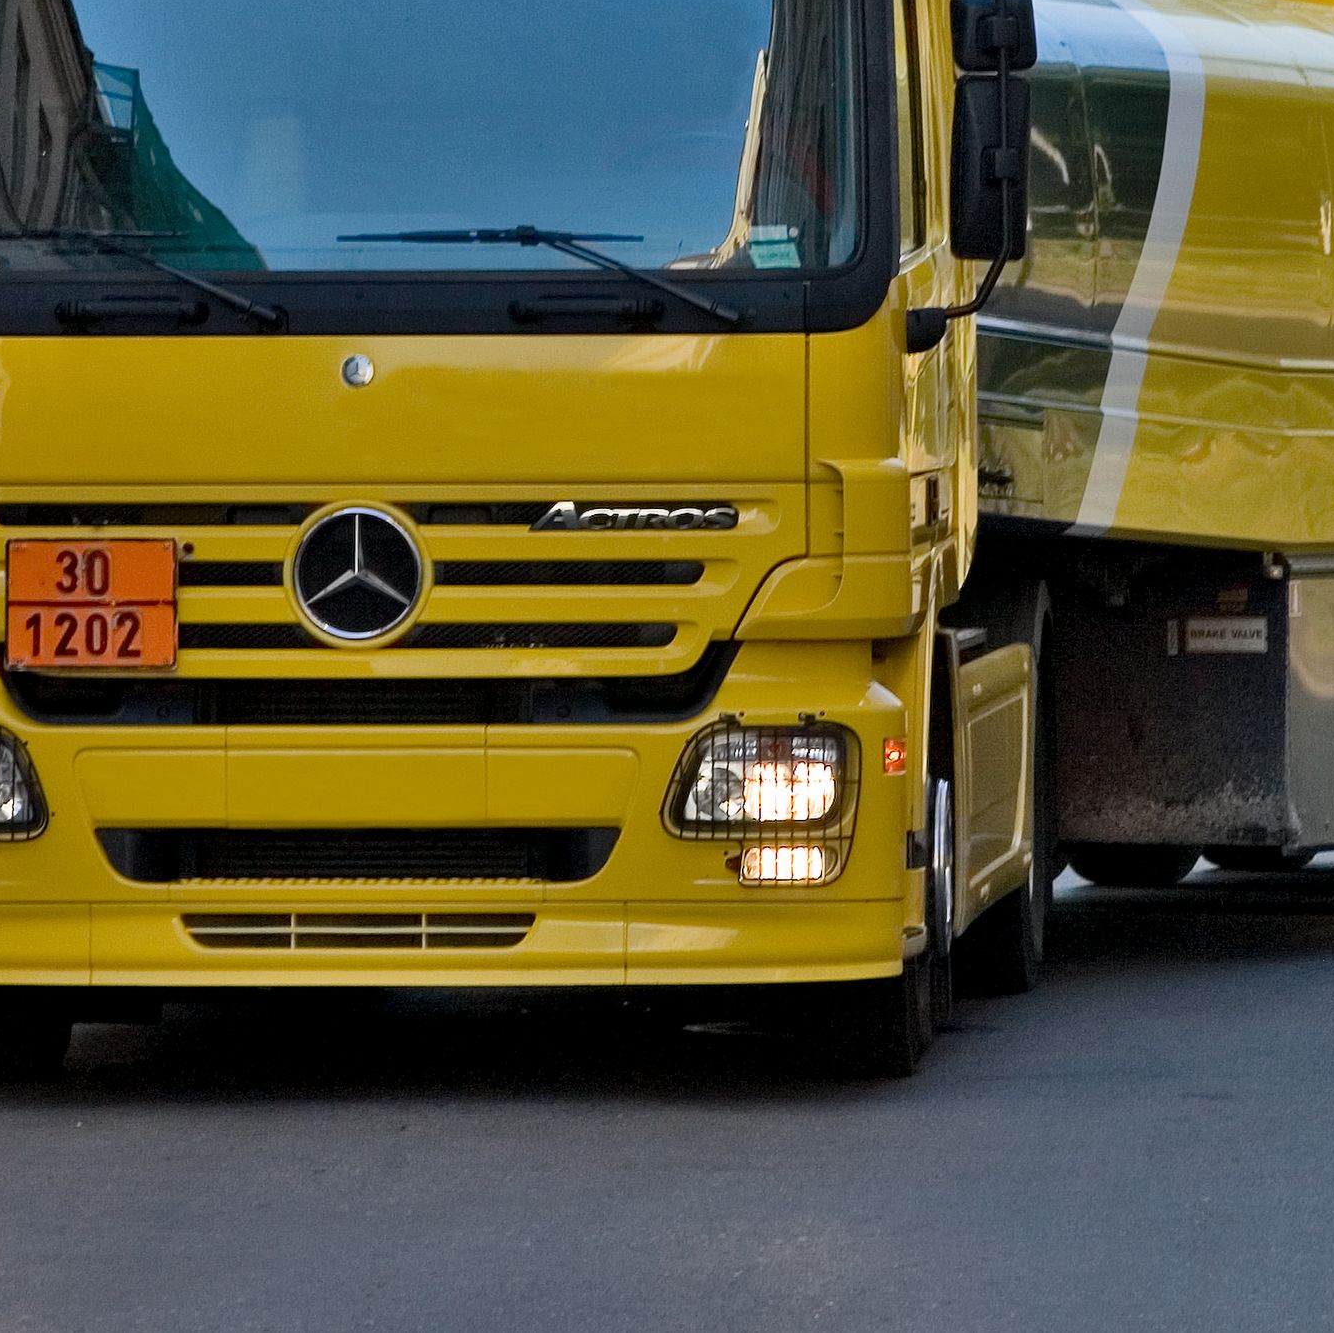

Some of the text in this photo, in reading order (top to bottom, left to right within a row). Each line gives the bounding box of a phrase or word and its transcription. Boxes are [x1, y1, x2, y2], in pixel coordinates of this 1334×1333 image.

[55, 549, 110, 596] 30
[26, 611, 142, 658] 1202
[1189, 627, 1262, 640] BRAKE VALVE
